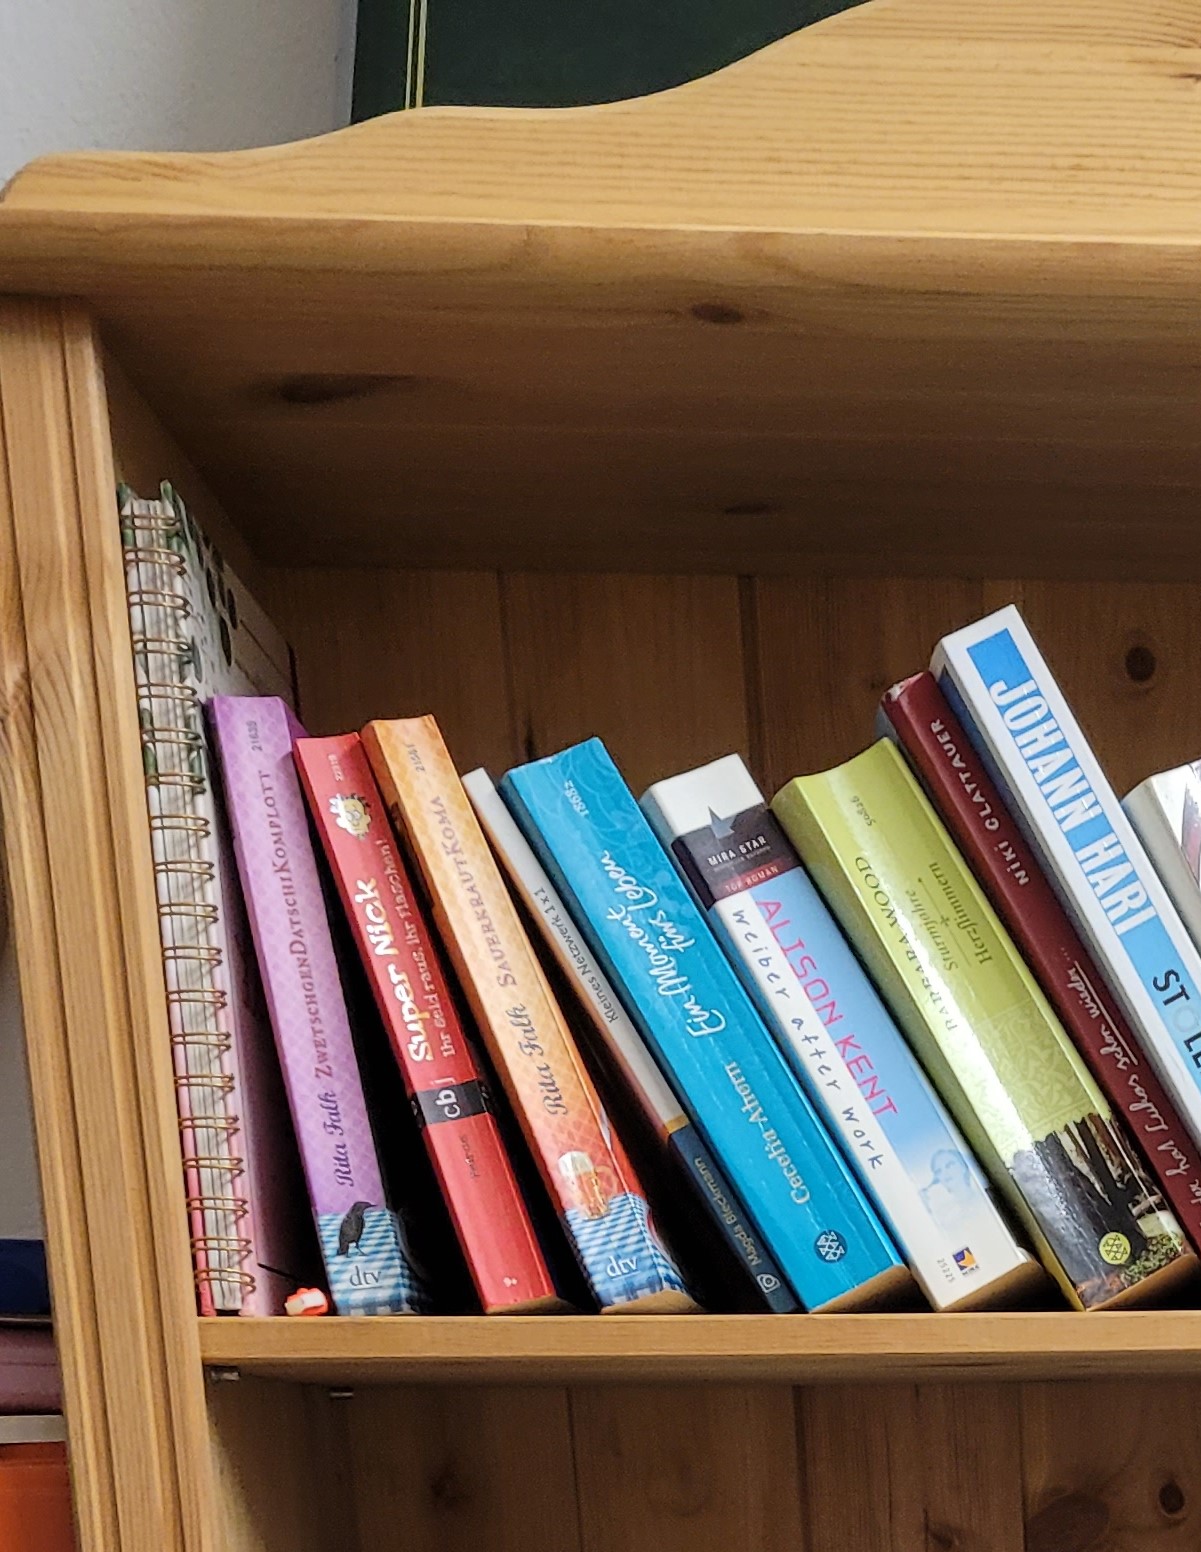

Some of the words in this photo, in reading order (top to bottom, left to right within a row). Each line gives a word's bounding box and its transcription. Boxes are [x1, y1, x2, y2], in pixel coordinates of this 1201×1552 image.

[984, 667, 1105, 834] JOHANN
[1074, 832, 1158, 936] HARI
[350, 874, 399, 960] Nick
[926, 859, 993, 965] Herzflimmern
[381, 958, 443, 1066] Super
[730, 905, 795, 1005] weiber
[789, 1011, 846, 1095] after
[840, 1103, 887, 1171] work
[753, 890, 846, 1028] ALISON
[832, 1031, 900, 1124] KENT
[719, 1059, 768, 1128] Ahern
[757, 1126, 812, 1206] Cecelia
[350, 1266, 381, 1287] dtv
[606, 1254, 639, 1278] dtv
